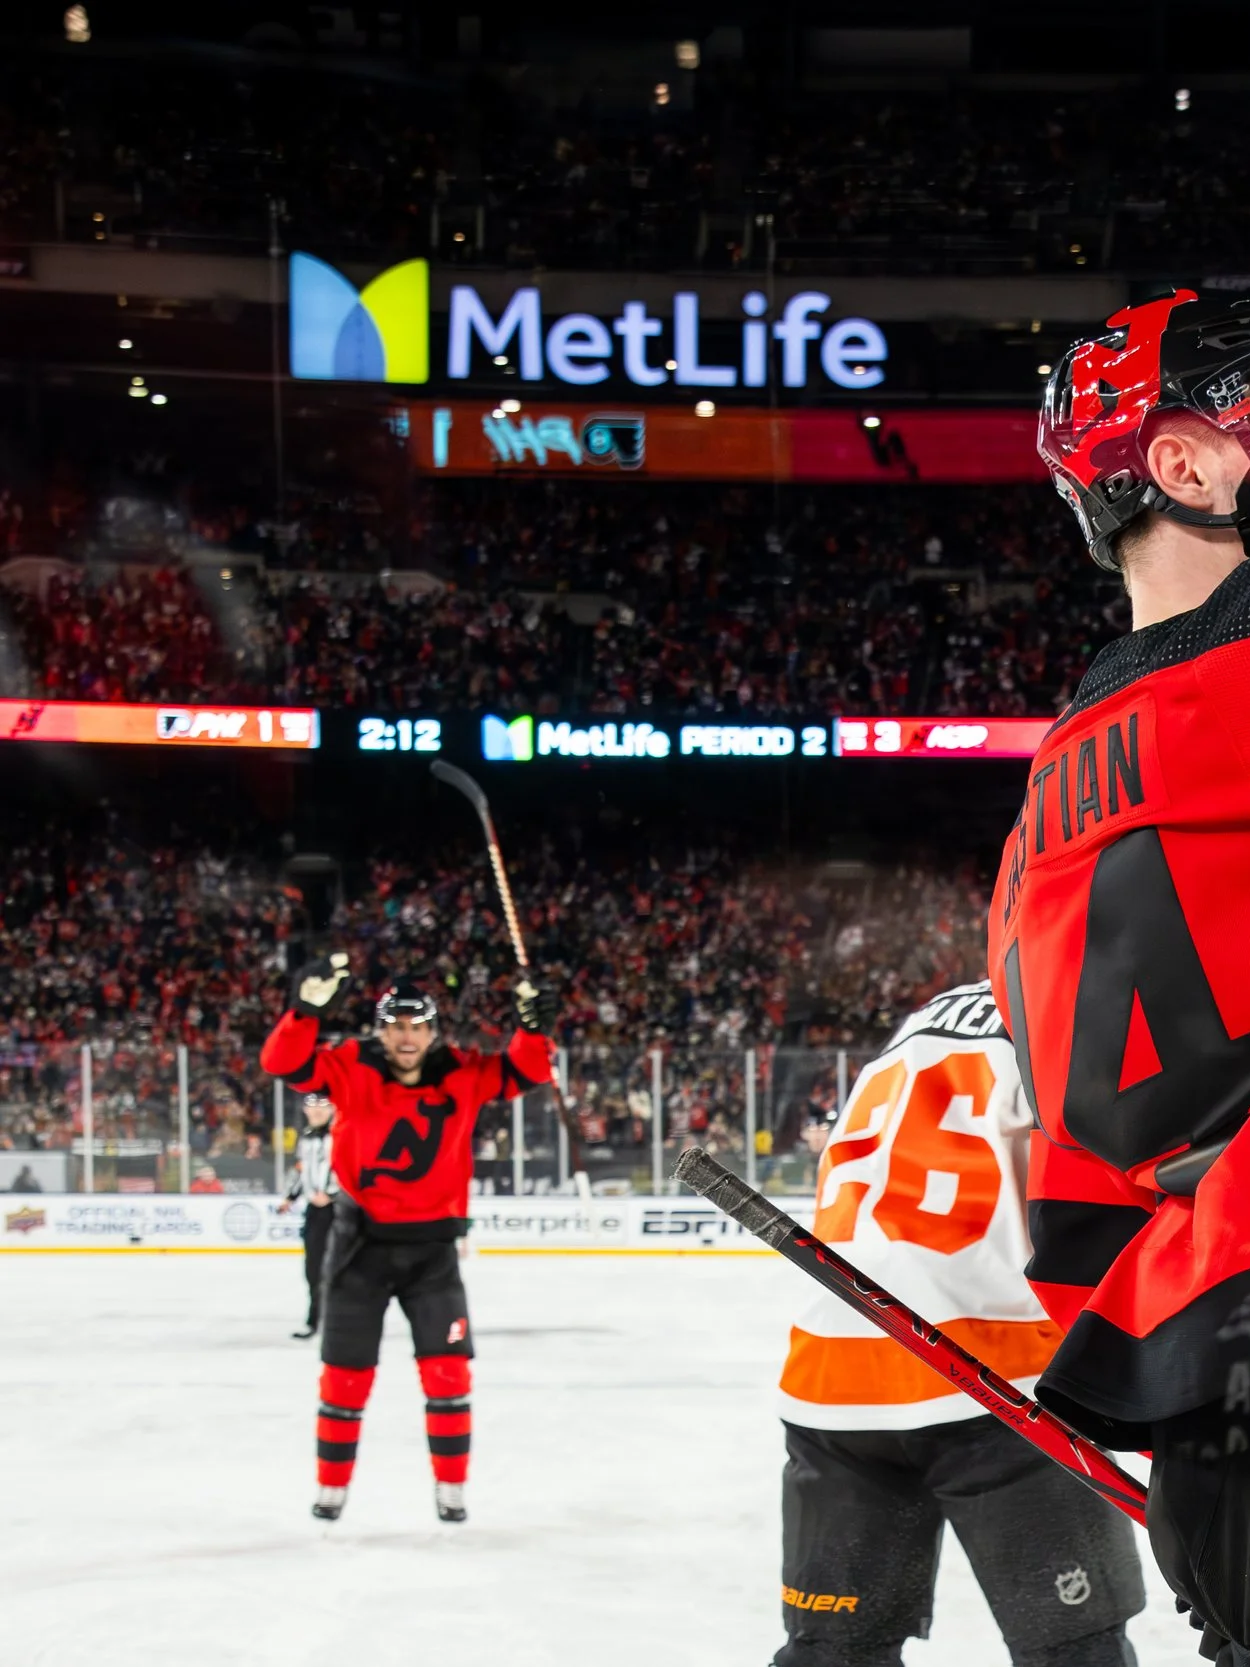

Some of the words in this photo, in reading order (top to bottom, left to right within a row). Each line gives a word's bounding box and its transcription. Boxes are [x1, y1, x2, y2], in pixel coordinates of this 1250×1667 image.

[447, 284, 889, 390] MetLife
[358, 718, 441, 751] 2:12
[537, 721, 670, 758] MetLife
[680, 725, 795, 756] PERIOD
[801, 726, 827, 756] 2
[873, 720, 901, 752] 3
[813, 1052, 1002, 1256] 26
